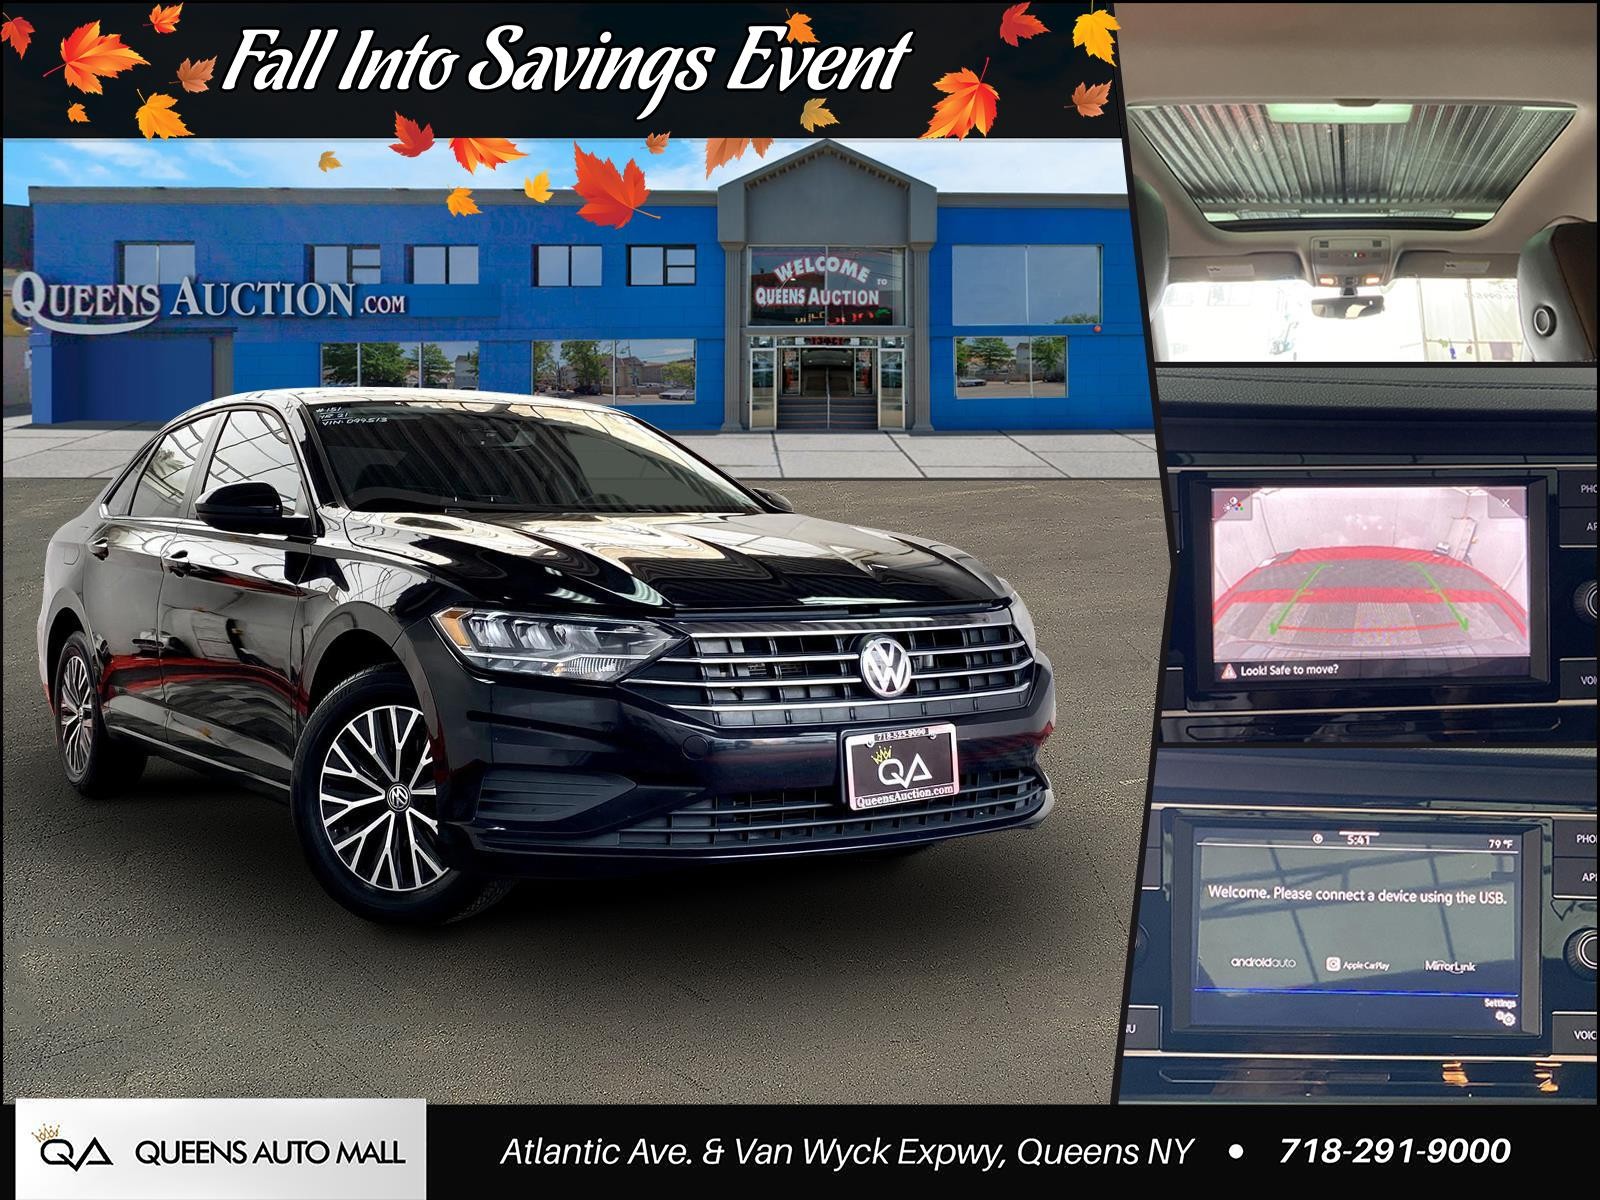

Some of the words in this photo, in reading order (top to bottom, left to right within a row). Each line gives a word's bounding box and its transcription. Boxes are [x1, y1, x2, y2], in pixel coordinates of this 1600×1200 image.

[774, 256, 871, 283] WELCOME
[877, 278, 888, 286] TO
[12, 271, 160, 335] QUEENS
[755, 287, 805, 305] QUEENS
[808, 287, 879, 305] AUCTION
[1241, 665, 1268, 677] Look!
[1269, 664, 1291, 676] Safe
[1293, 665, 1304, 675] to
[1306, 663, 1339, 675] move?
[856, 783, 955, 808] QueensAuction.com
[1346, 834, 1371, 846] 5:41
[1488, 839, 1501, 849] 79
[1208, 884, 1270, 899] Welcome.
[1273, 886, 1312, 900] Please
[1315, 888, 1365, 902] connect
[1367, 891, 1375, 902] a
[1377, 889, 1418, 903] device
[1420, 890, 1453, 906] using
[1455, 890, 1476, 904] the
[1479, 891, 1507, 905] USB.
[1424, 960, 1476, 974] MirrorLink
[1484, 998, 1517, 1009] Settings
